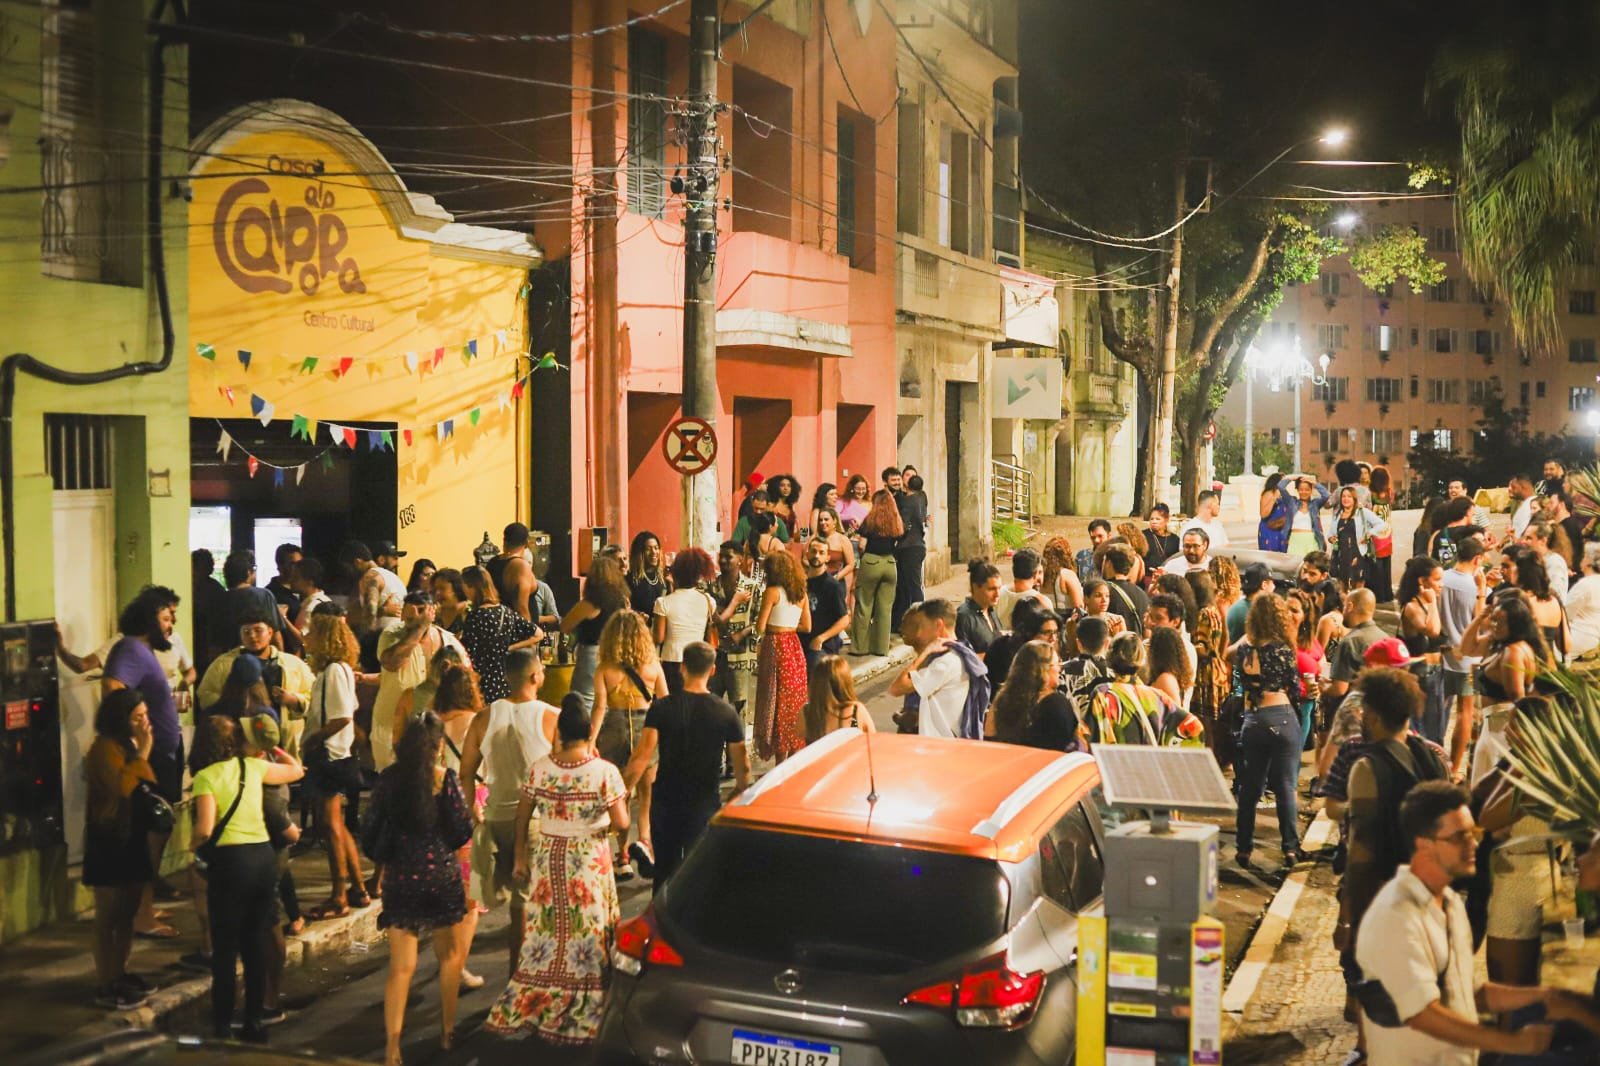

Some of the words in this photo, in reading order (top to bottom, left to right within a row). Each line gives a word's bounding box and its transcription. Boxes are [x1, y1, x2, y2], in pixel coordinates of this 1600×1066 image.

[303, 310, 337, 329] Centro
[340, 313, 375, 332] Cultural
[399, 503, 416, 529] 168
